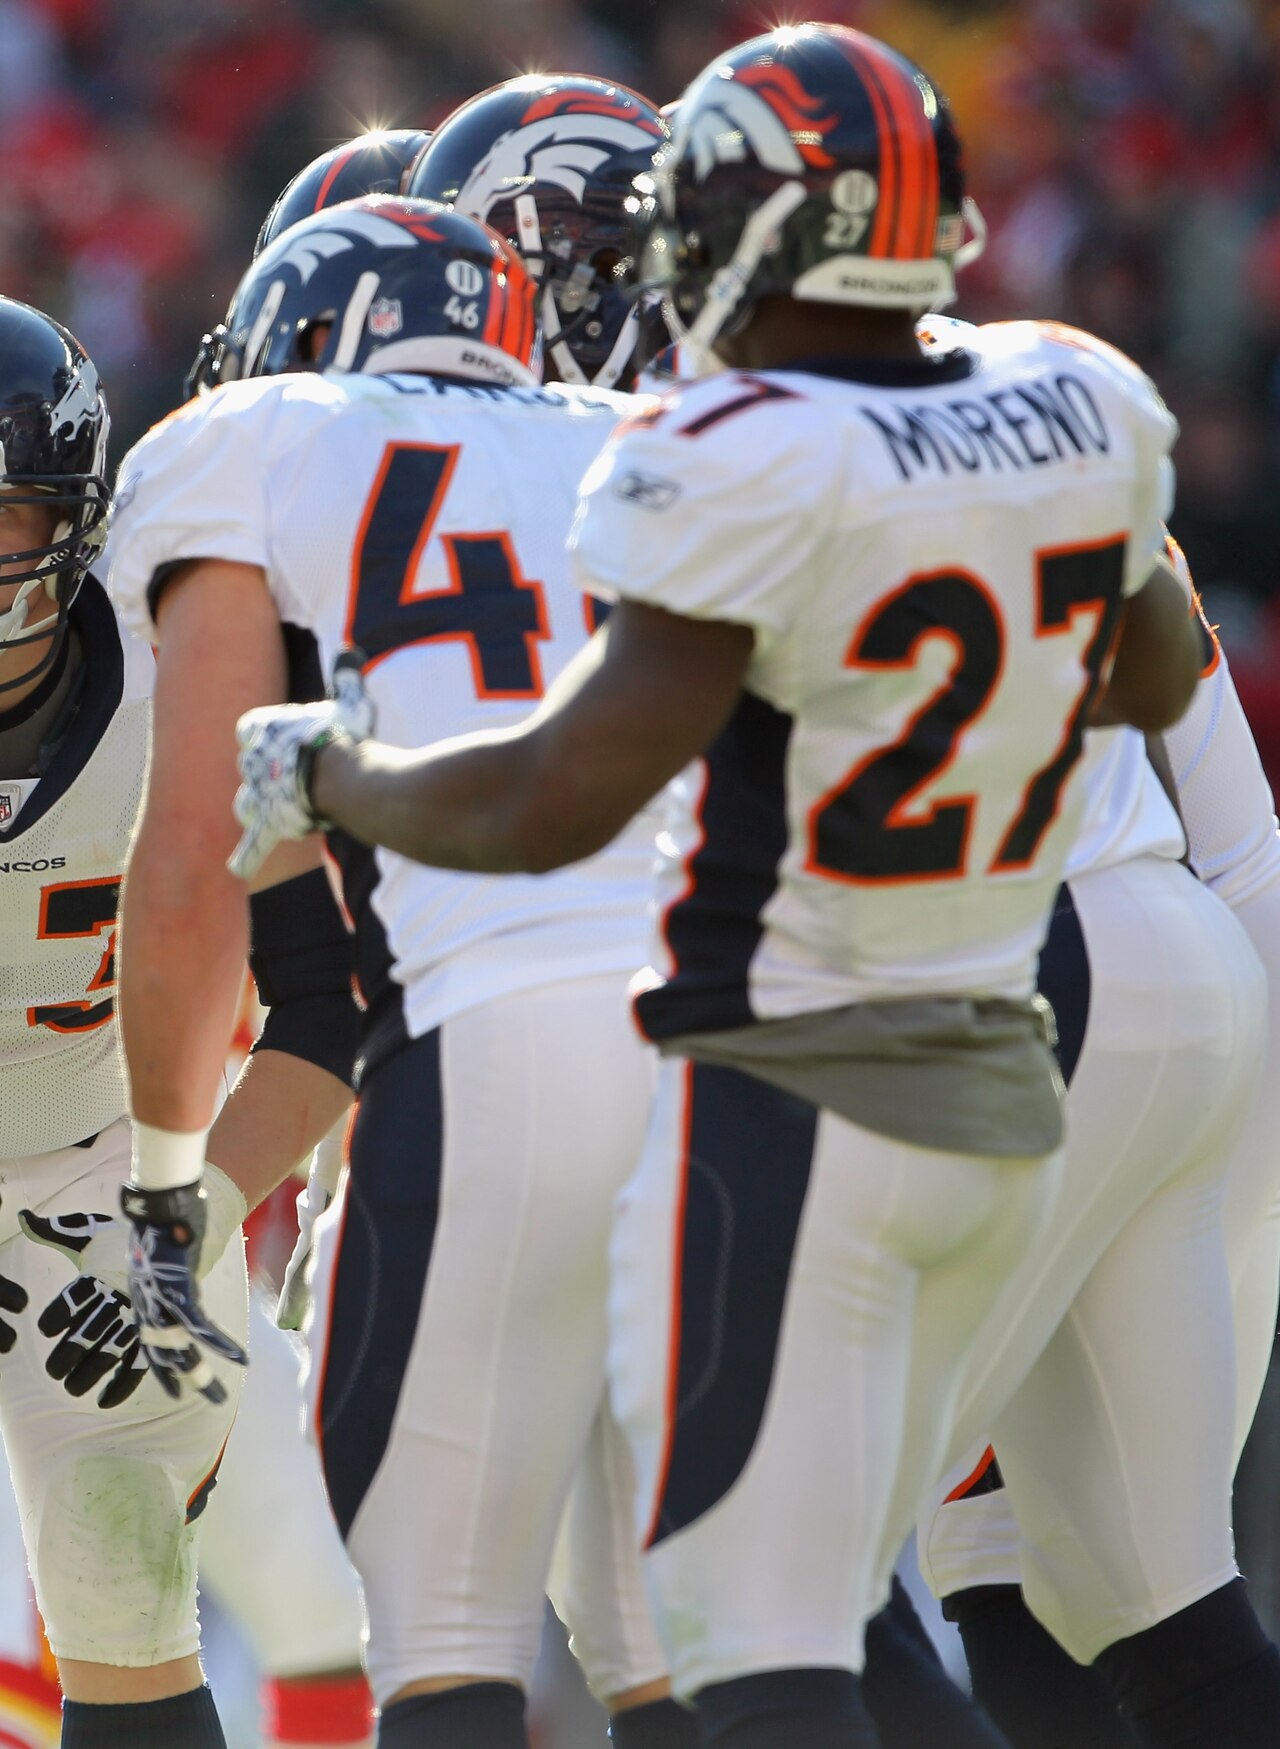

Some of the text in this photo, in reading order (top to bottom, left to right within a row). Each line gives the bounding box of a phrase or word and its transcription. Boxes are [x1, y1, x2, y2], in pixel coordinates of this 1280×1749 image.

[443, 295, 480, 330] 46
[859, 372, 1112, 482] MORENO
[344, 441, 615, 701] 4
[802, 530, 1132, 886] 27
